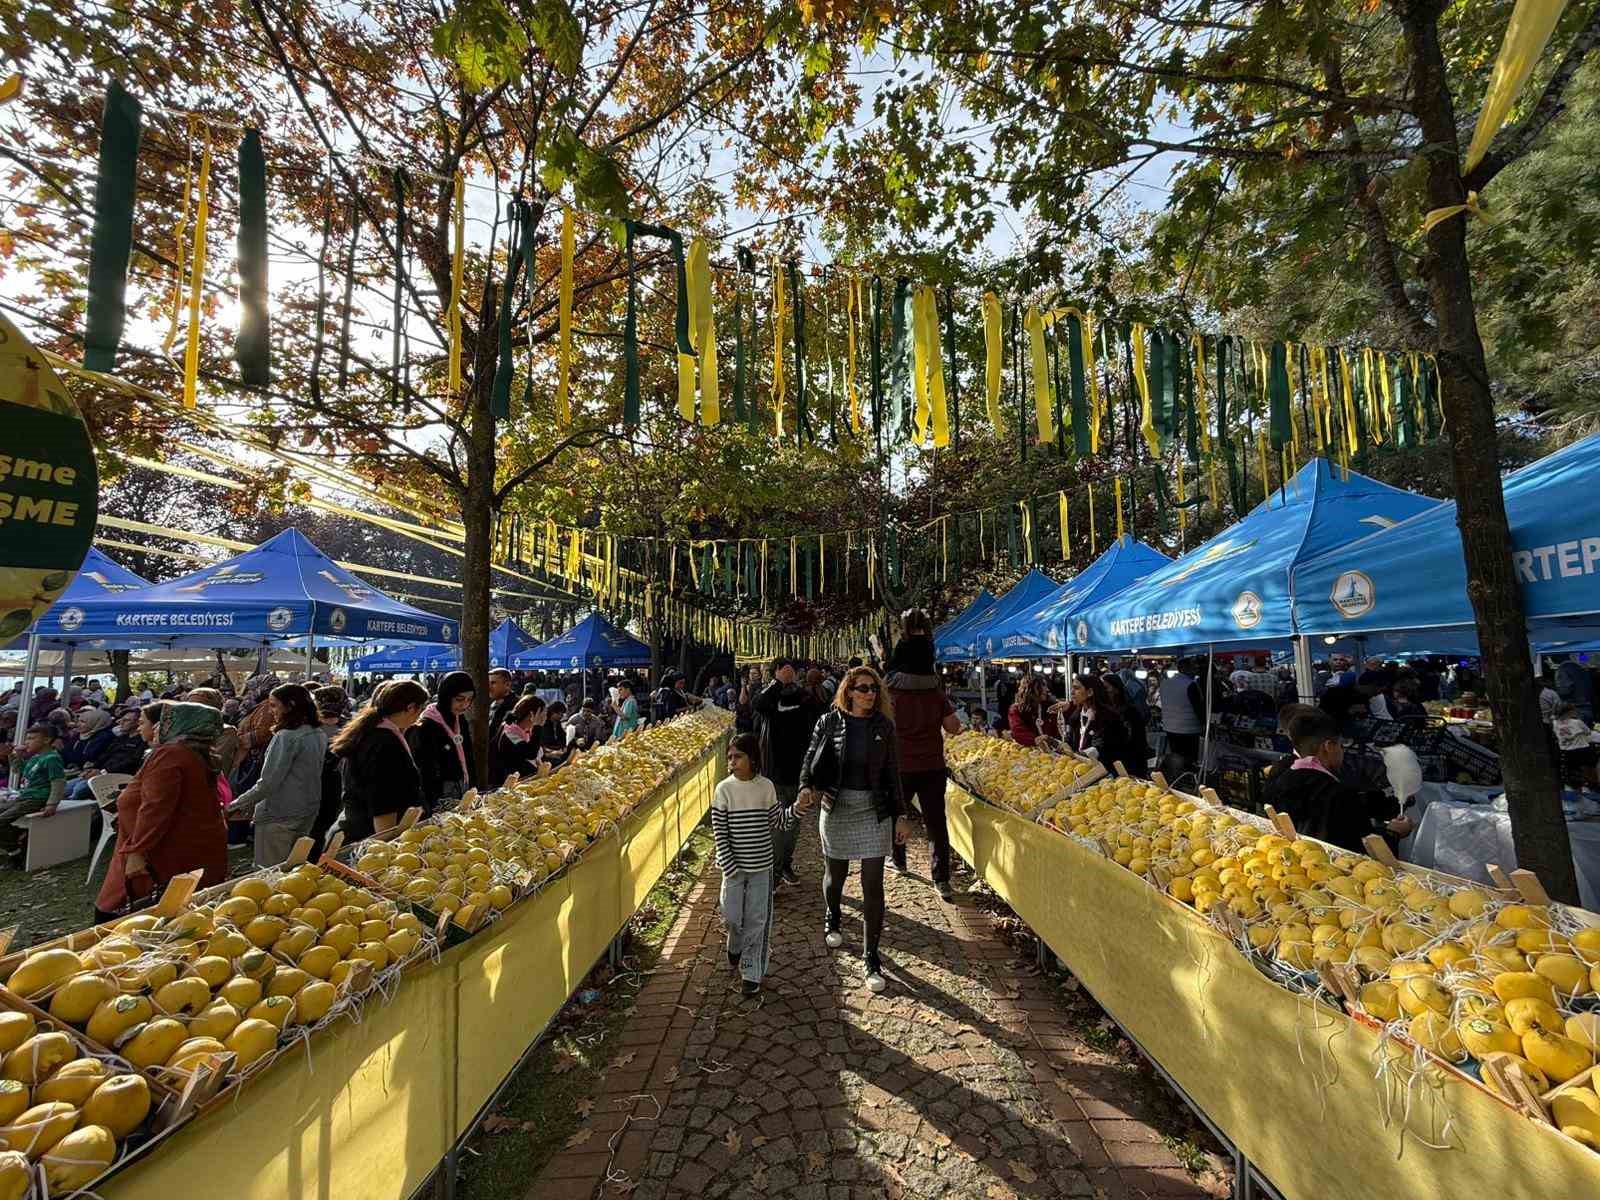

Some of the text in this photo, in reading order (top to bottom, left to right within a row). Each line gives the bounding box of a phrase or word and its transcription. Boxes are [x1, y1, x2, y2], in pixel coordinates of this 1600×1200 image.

[116, 612, 235, 626] KARTEPE BELEDİYESİ
[1111, 616, 1145, 634] KARTEPE
